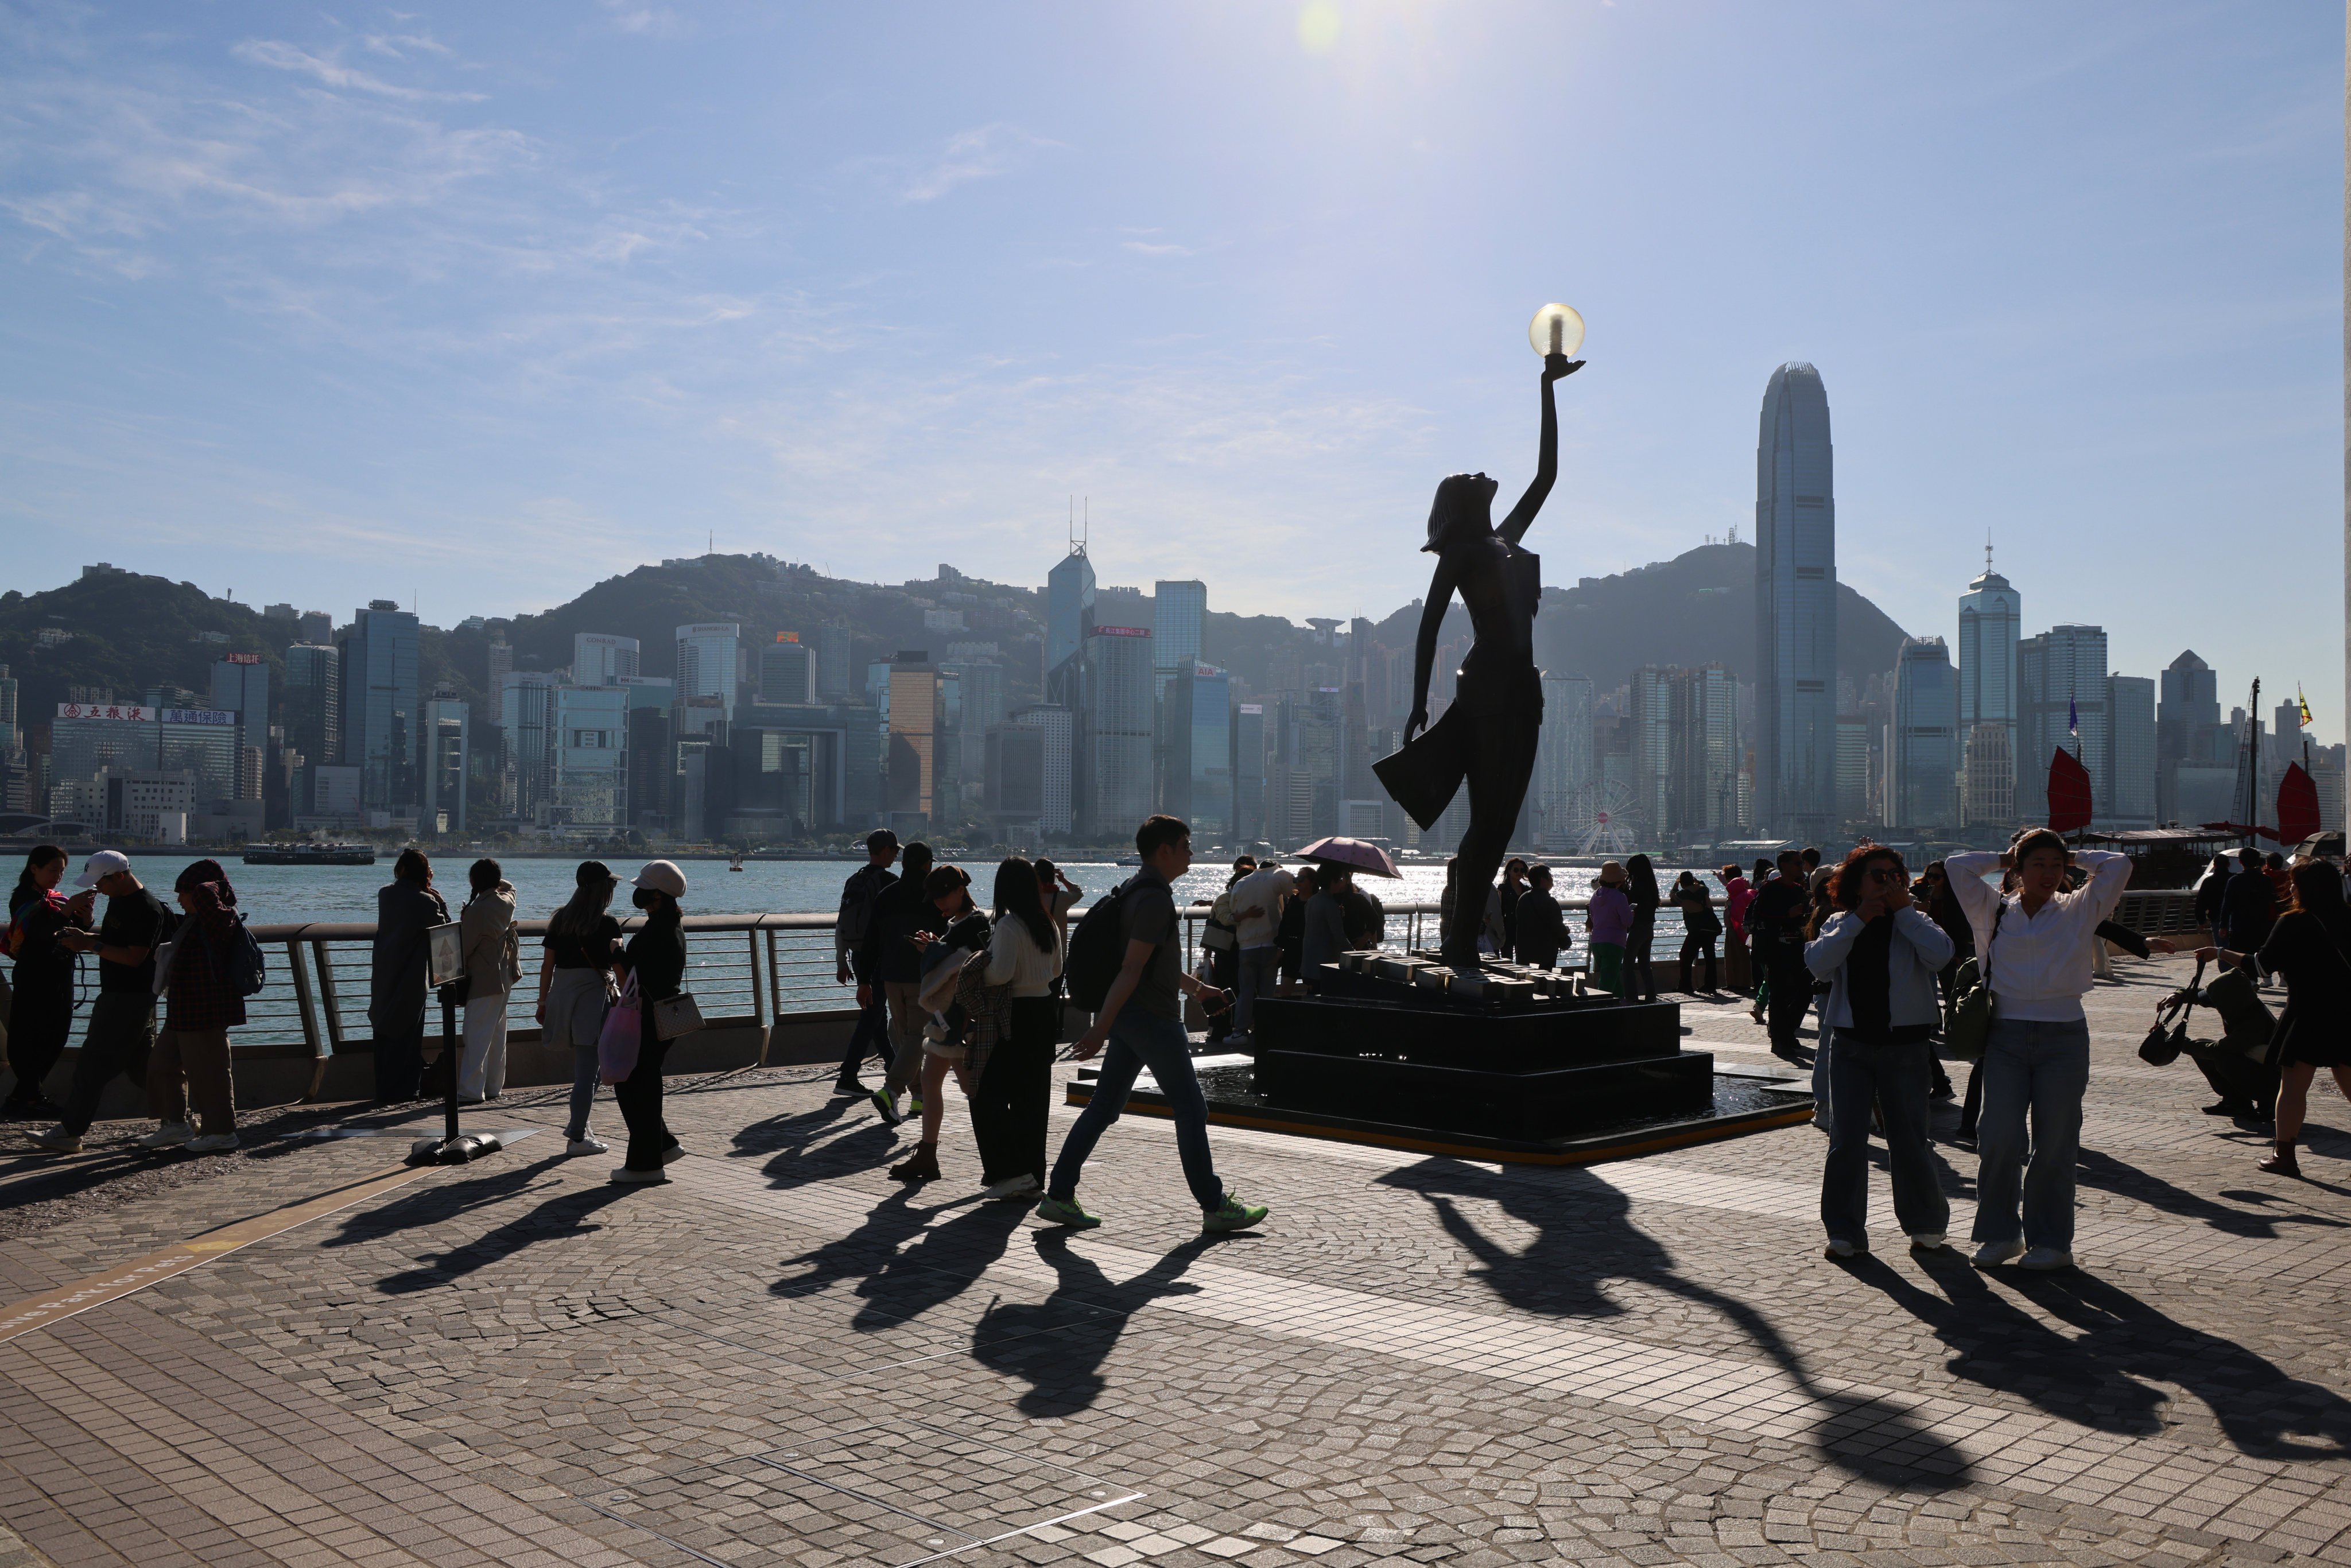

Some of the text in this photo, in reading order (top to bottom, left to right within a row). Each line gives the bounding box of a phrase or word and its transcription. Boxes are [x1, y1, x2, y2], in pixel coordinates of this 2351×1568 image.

[227, 653, 259, 663] 上海信托
[170, 709, 227, 724] 萬通保險
[37, 1289, 110, 1308] Park
[96, 1274, 143, 1286] for
[133, 1255, 195, 1272] Pets
